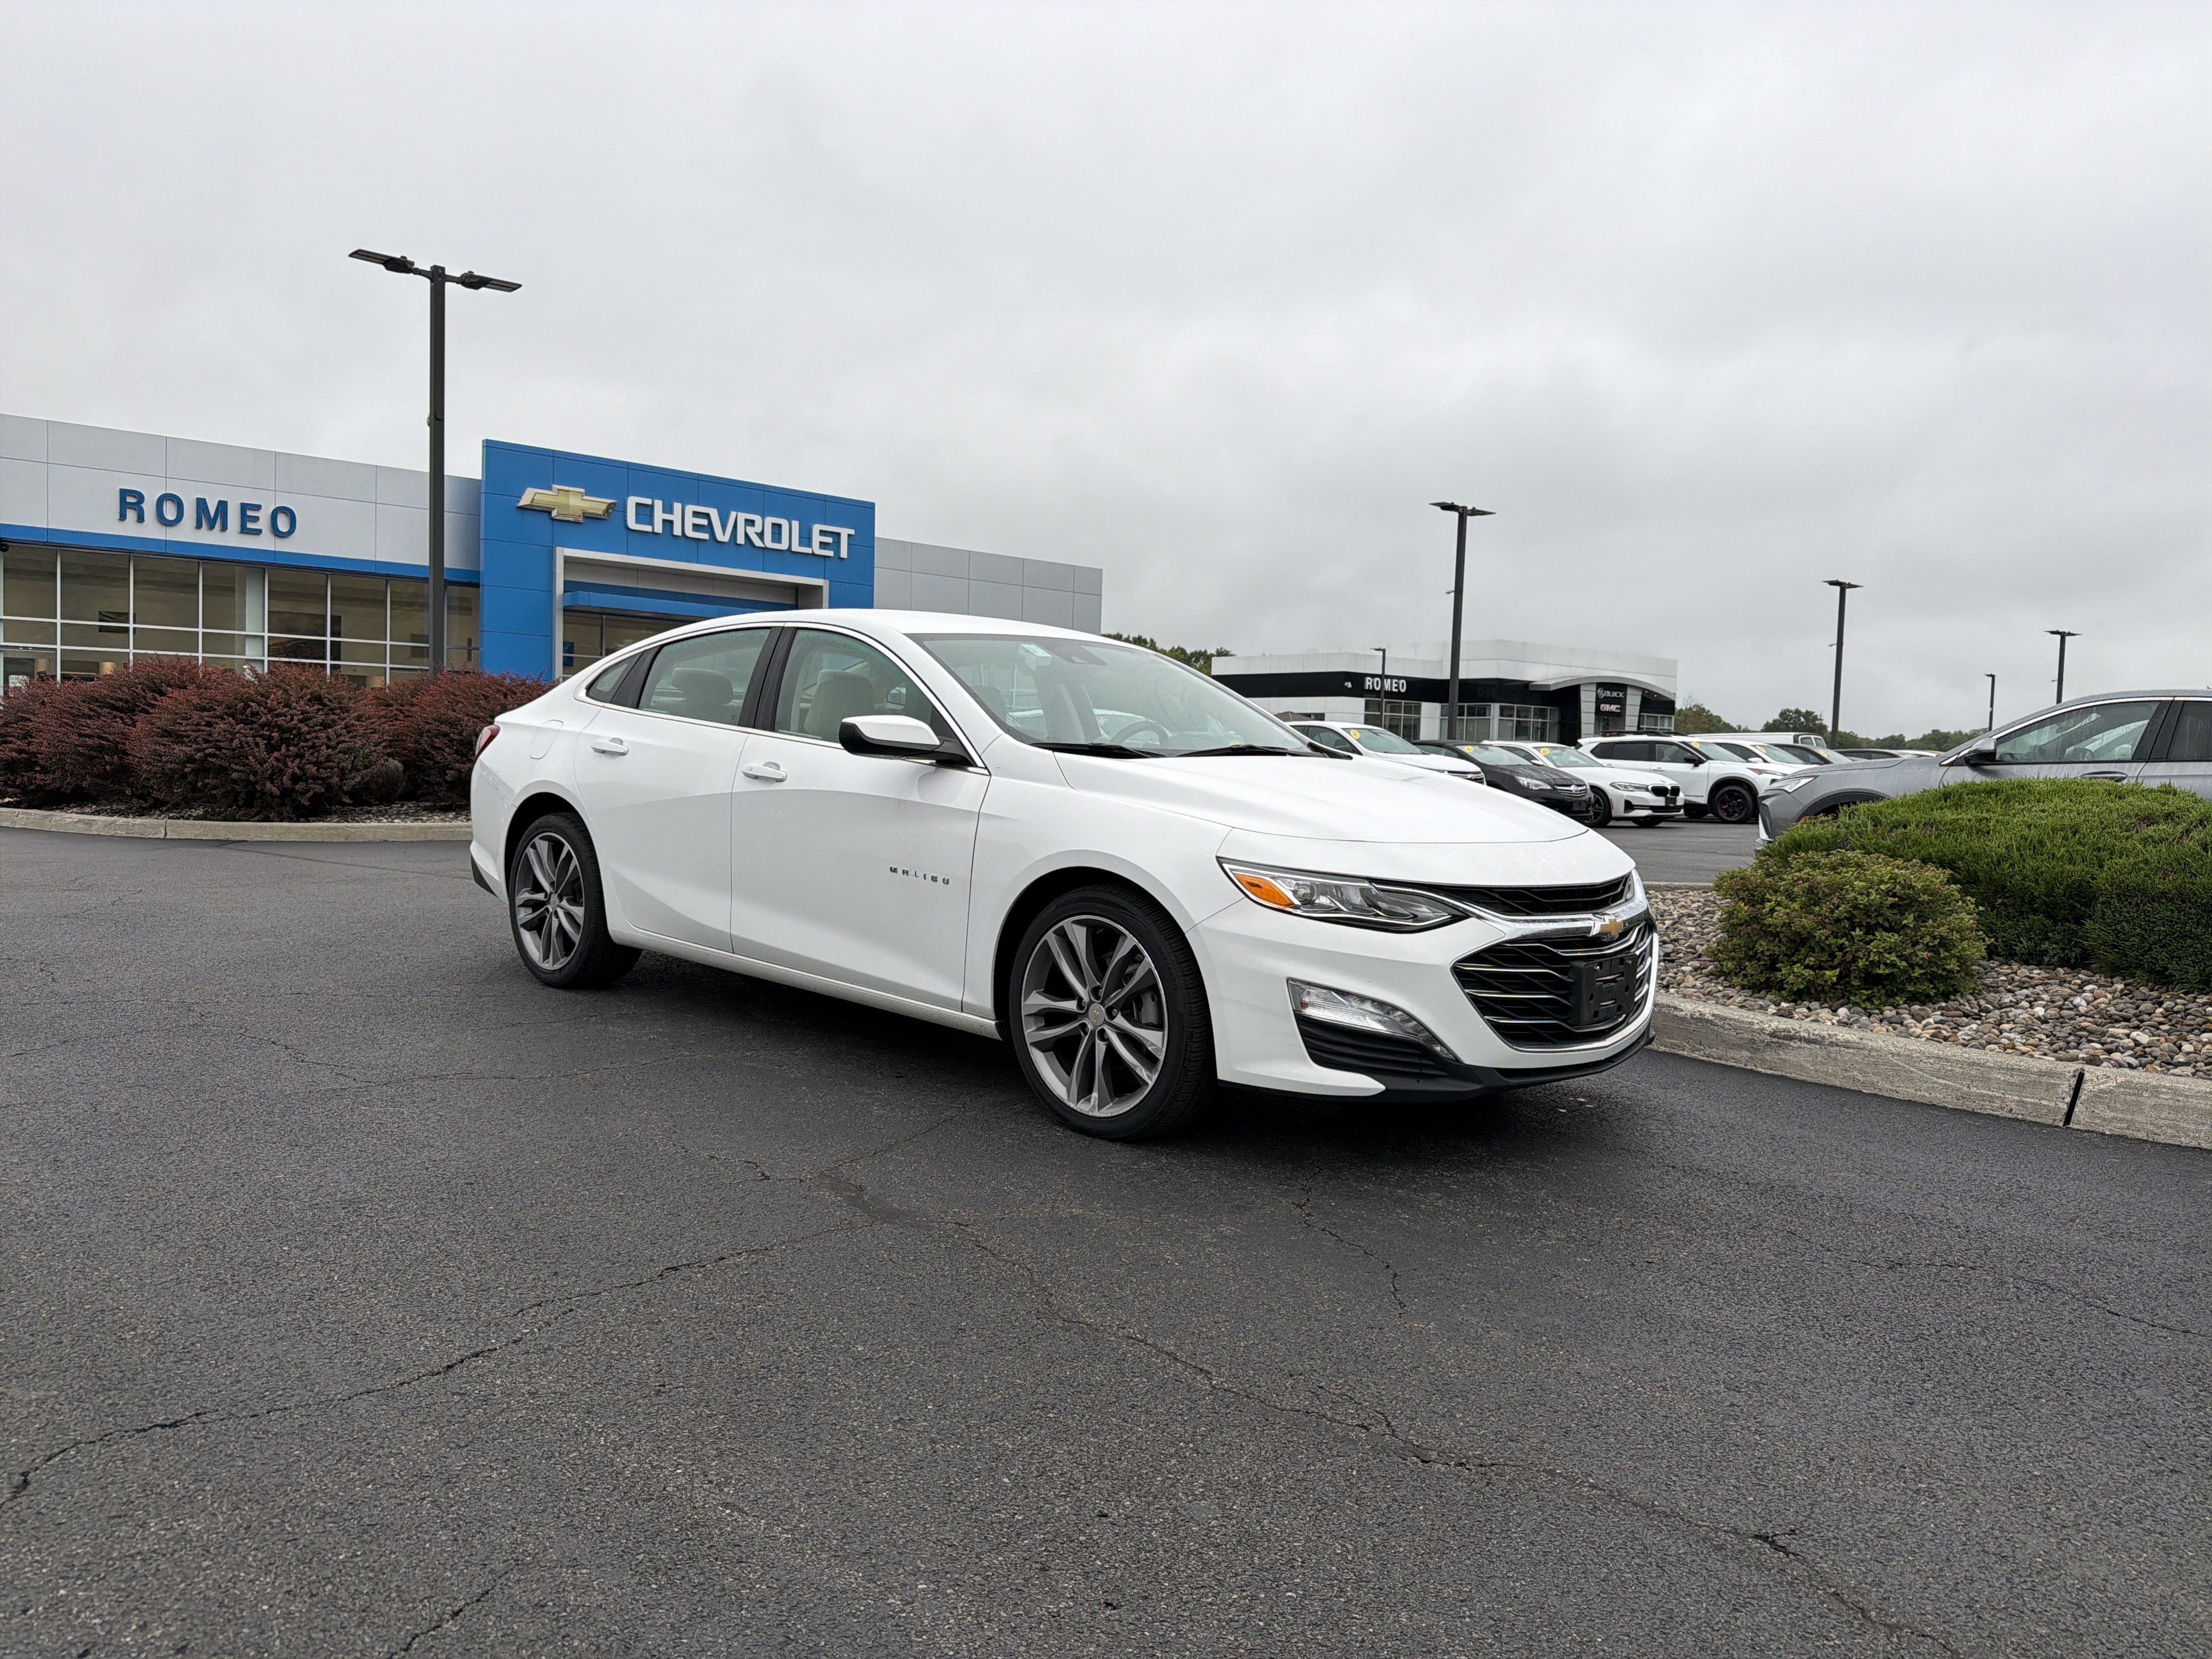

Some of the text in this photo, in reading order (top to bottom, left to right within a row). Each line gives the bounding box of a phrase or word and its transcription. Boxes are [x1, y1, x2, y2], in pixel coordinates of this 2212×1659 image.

[119, 488, 297, 538] ROMEO
[627, 496, 855, 558] CHEVROLET
[1364, 676, 1407, 692] ROMEO
[1600, 703, 1621, 712] GMC
[889, 866, 950, 885] MALIBU
